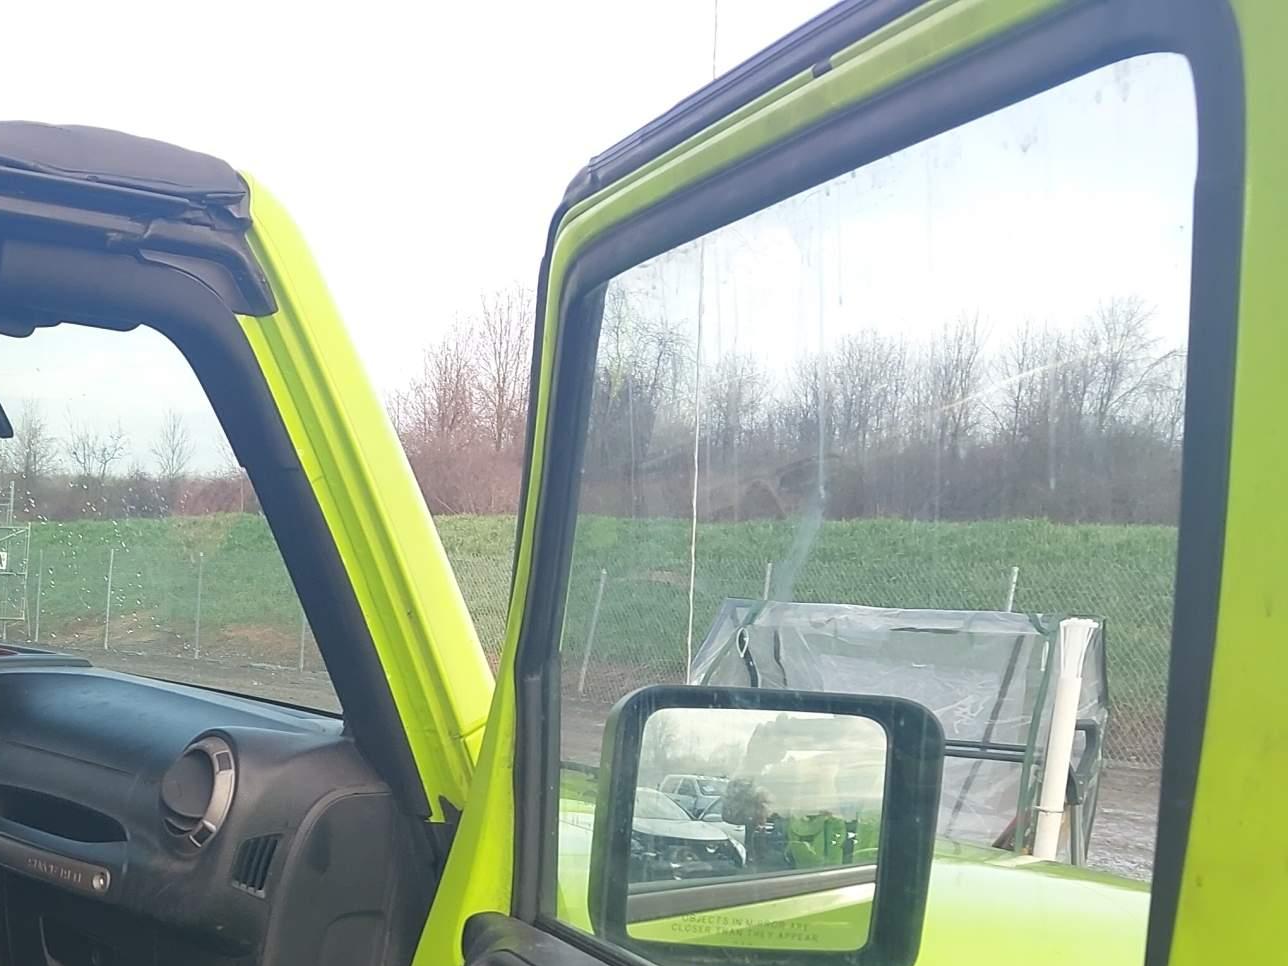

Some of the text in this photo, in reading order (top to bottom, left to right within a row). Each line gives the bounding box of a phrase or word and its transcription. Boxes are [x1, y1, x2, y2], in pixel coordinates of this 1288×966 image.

[682, 914, 729, 926] OBJECTS
[671, 922, 819, 943] CLOSER THAN THEY APPEAR
